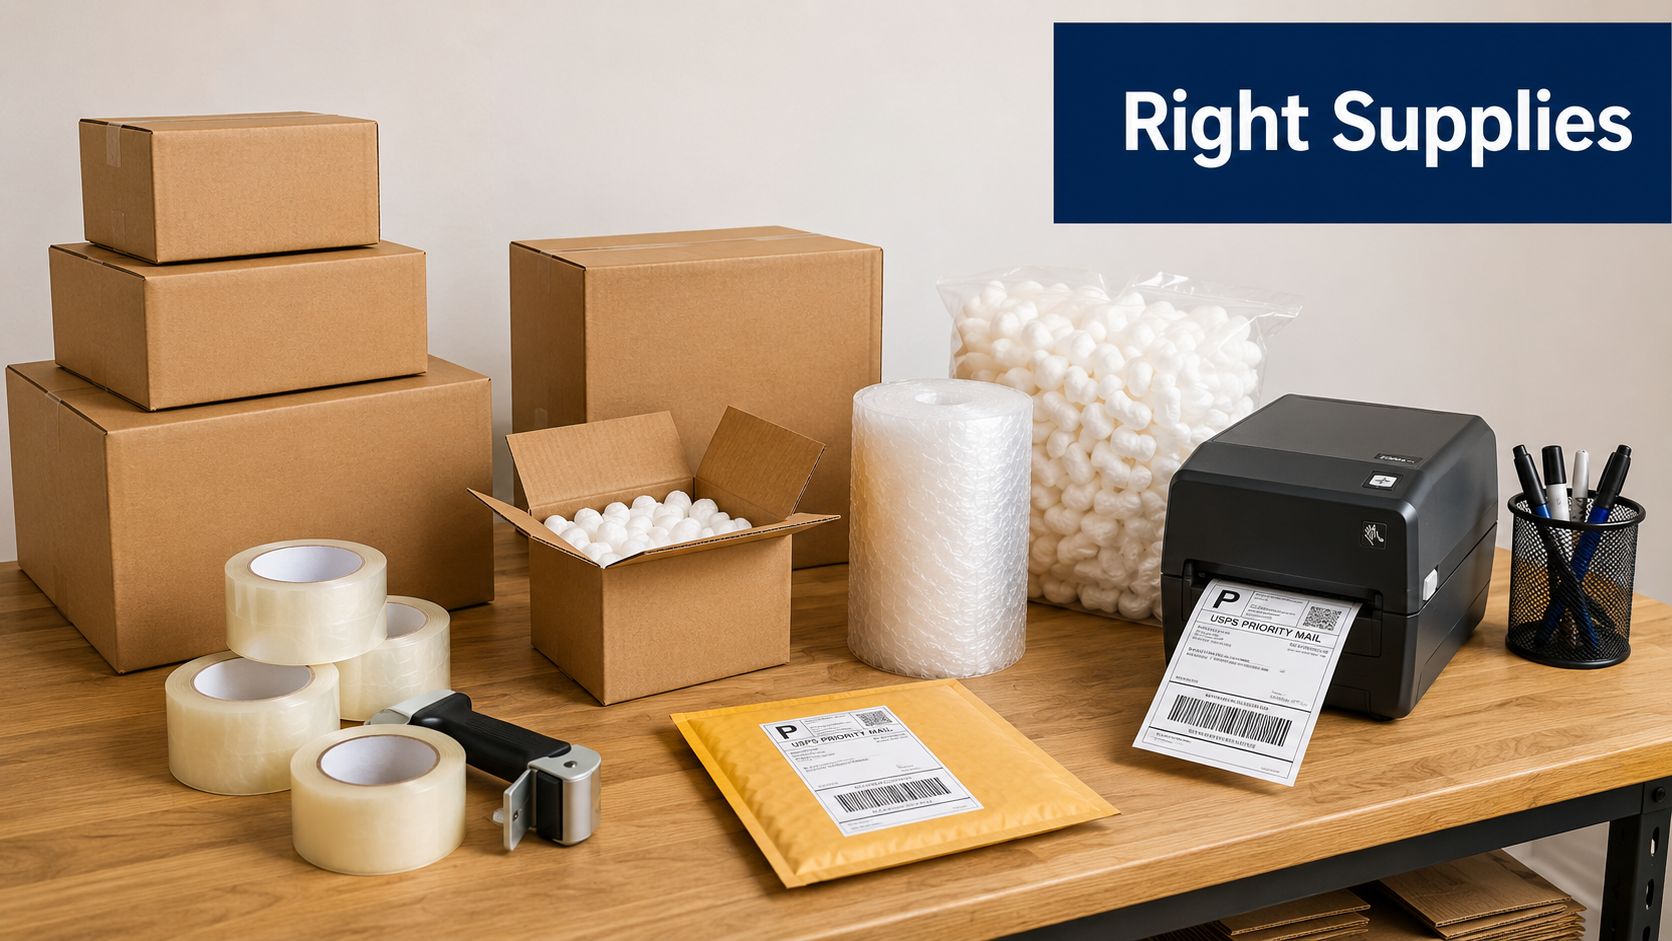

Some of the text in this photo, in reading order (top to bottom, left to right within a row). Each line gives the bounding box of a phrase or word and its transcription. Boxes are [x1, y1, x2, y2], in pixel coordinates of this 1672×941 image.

[1212, 589, 1241, 609] P
[1210, 614, 1239, 627] USPS
[1241, 620, 1294, 638] PRIORITY
[1294, 630, 1322, 644] MAIL
[775, 724, 798, 740] P
[820, 731, 866, 743] PRIORITY
[868, 727, 894, 735] MAIL
